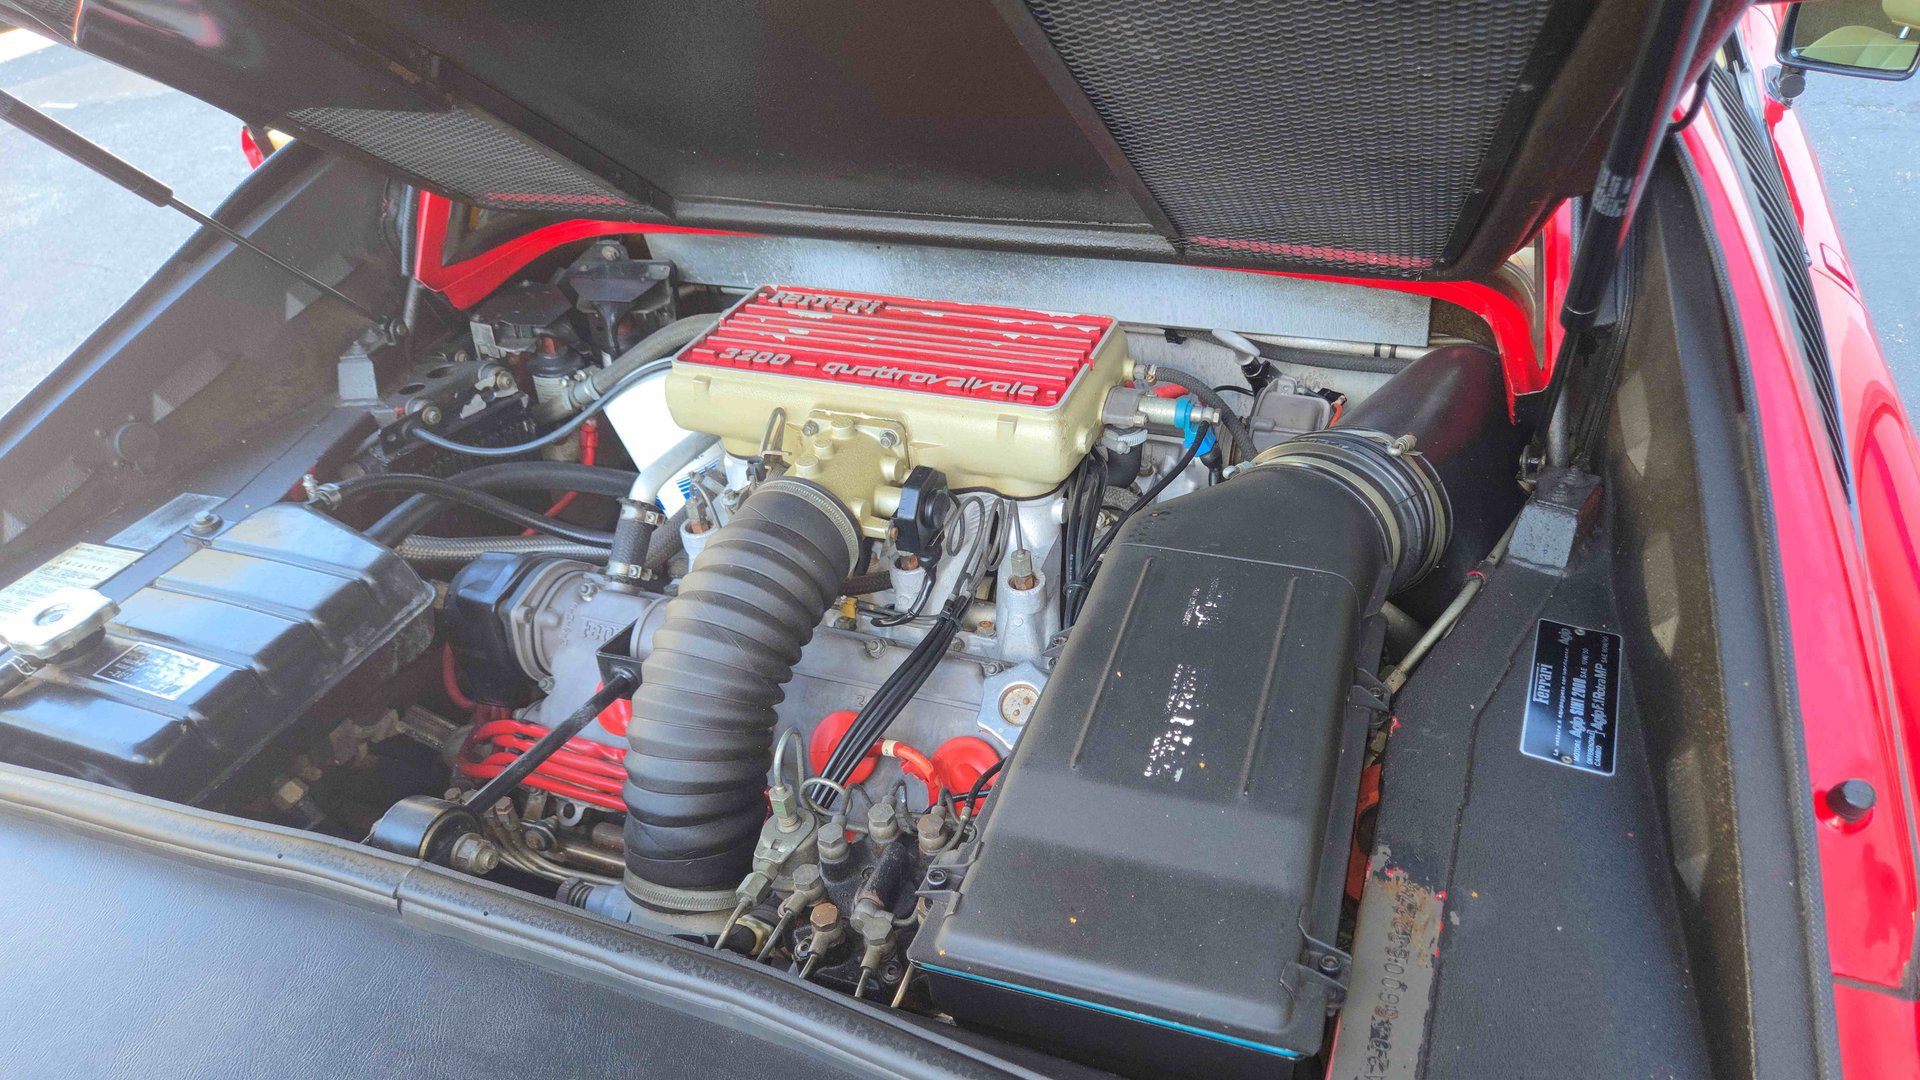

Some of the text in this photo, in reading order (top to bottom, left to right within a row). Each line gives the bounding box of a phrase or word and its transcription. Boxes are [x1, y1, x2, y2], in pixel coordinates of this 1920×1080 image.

[719, 347, 1039, 397] 3200 quattrovalvole
[1580, 667, 1588, 678] SAE
[1532, 663, 1553, 705] Ferrari
[1571, 677, 1587, 699] 2000
[1569, 697, 1585, 716] SINT
[1569, 716, 1586, 739] Agip
[1590, 710, 1608, 731] Agip
[1573, 739, 1582, 762] MOTORE
[1593, 745, 1603, 767] CAMBIO
